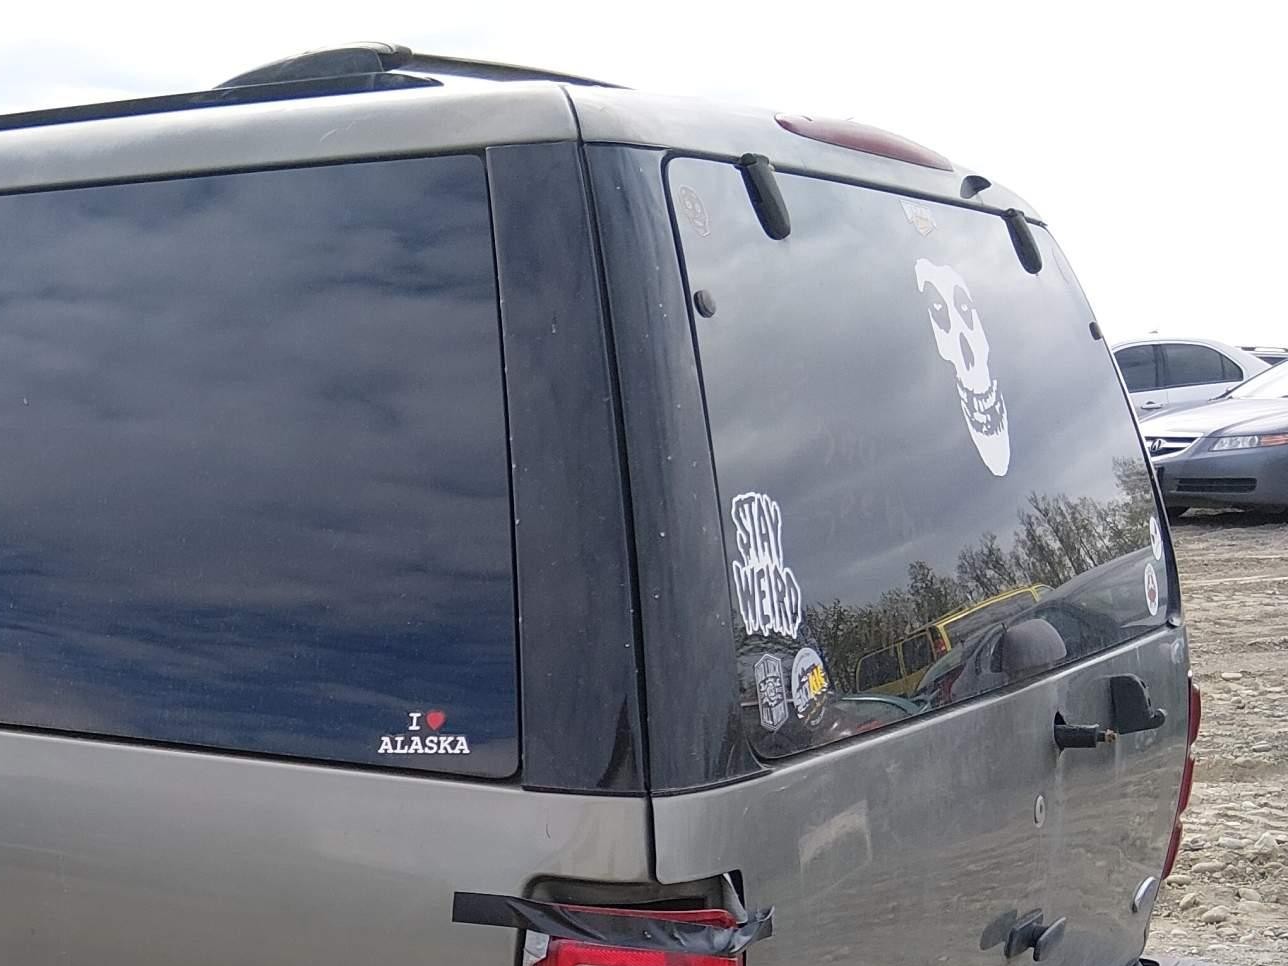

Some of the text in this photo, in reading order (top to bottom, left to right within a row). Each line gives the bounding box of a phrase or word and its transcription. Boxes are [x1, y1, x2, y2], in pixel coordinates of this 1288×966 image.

[731, 491, 784, 569] STAY
[732, 560, 801, 640] WEIRD
[377, 735, 471, 754] ALASKA
[408, 712, 422, 731] I
